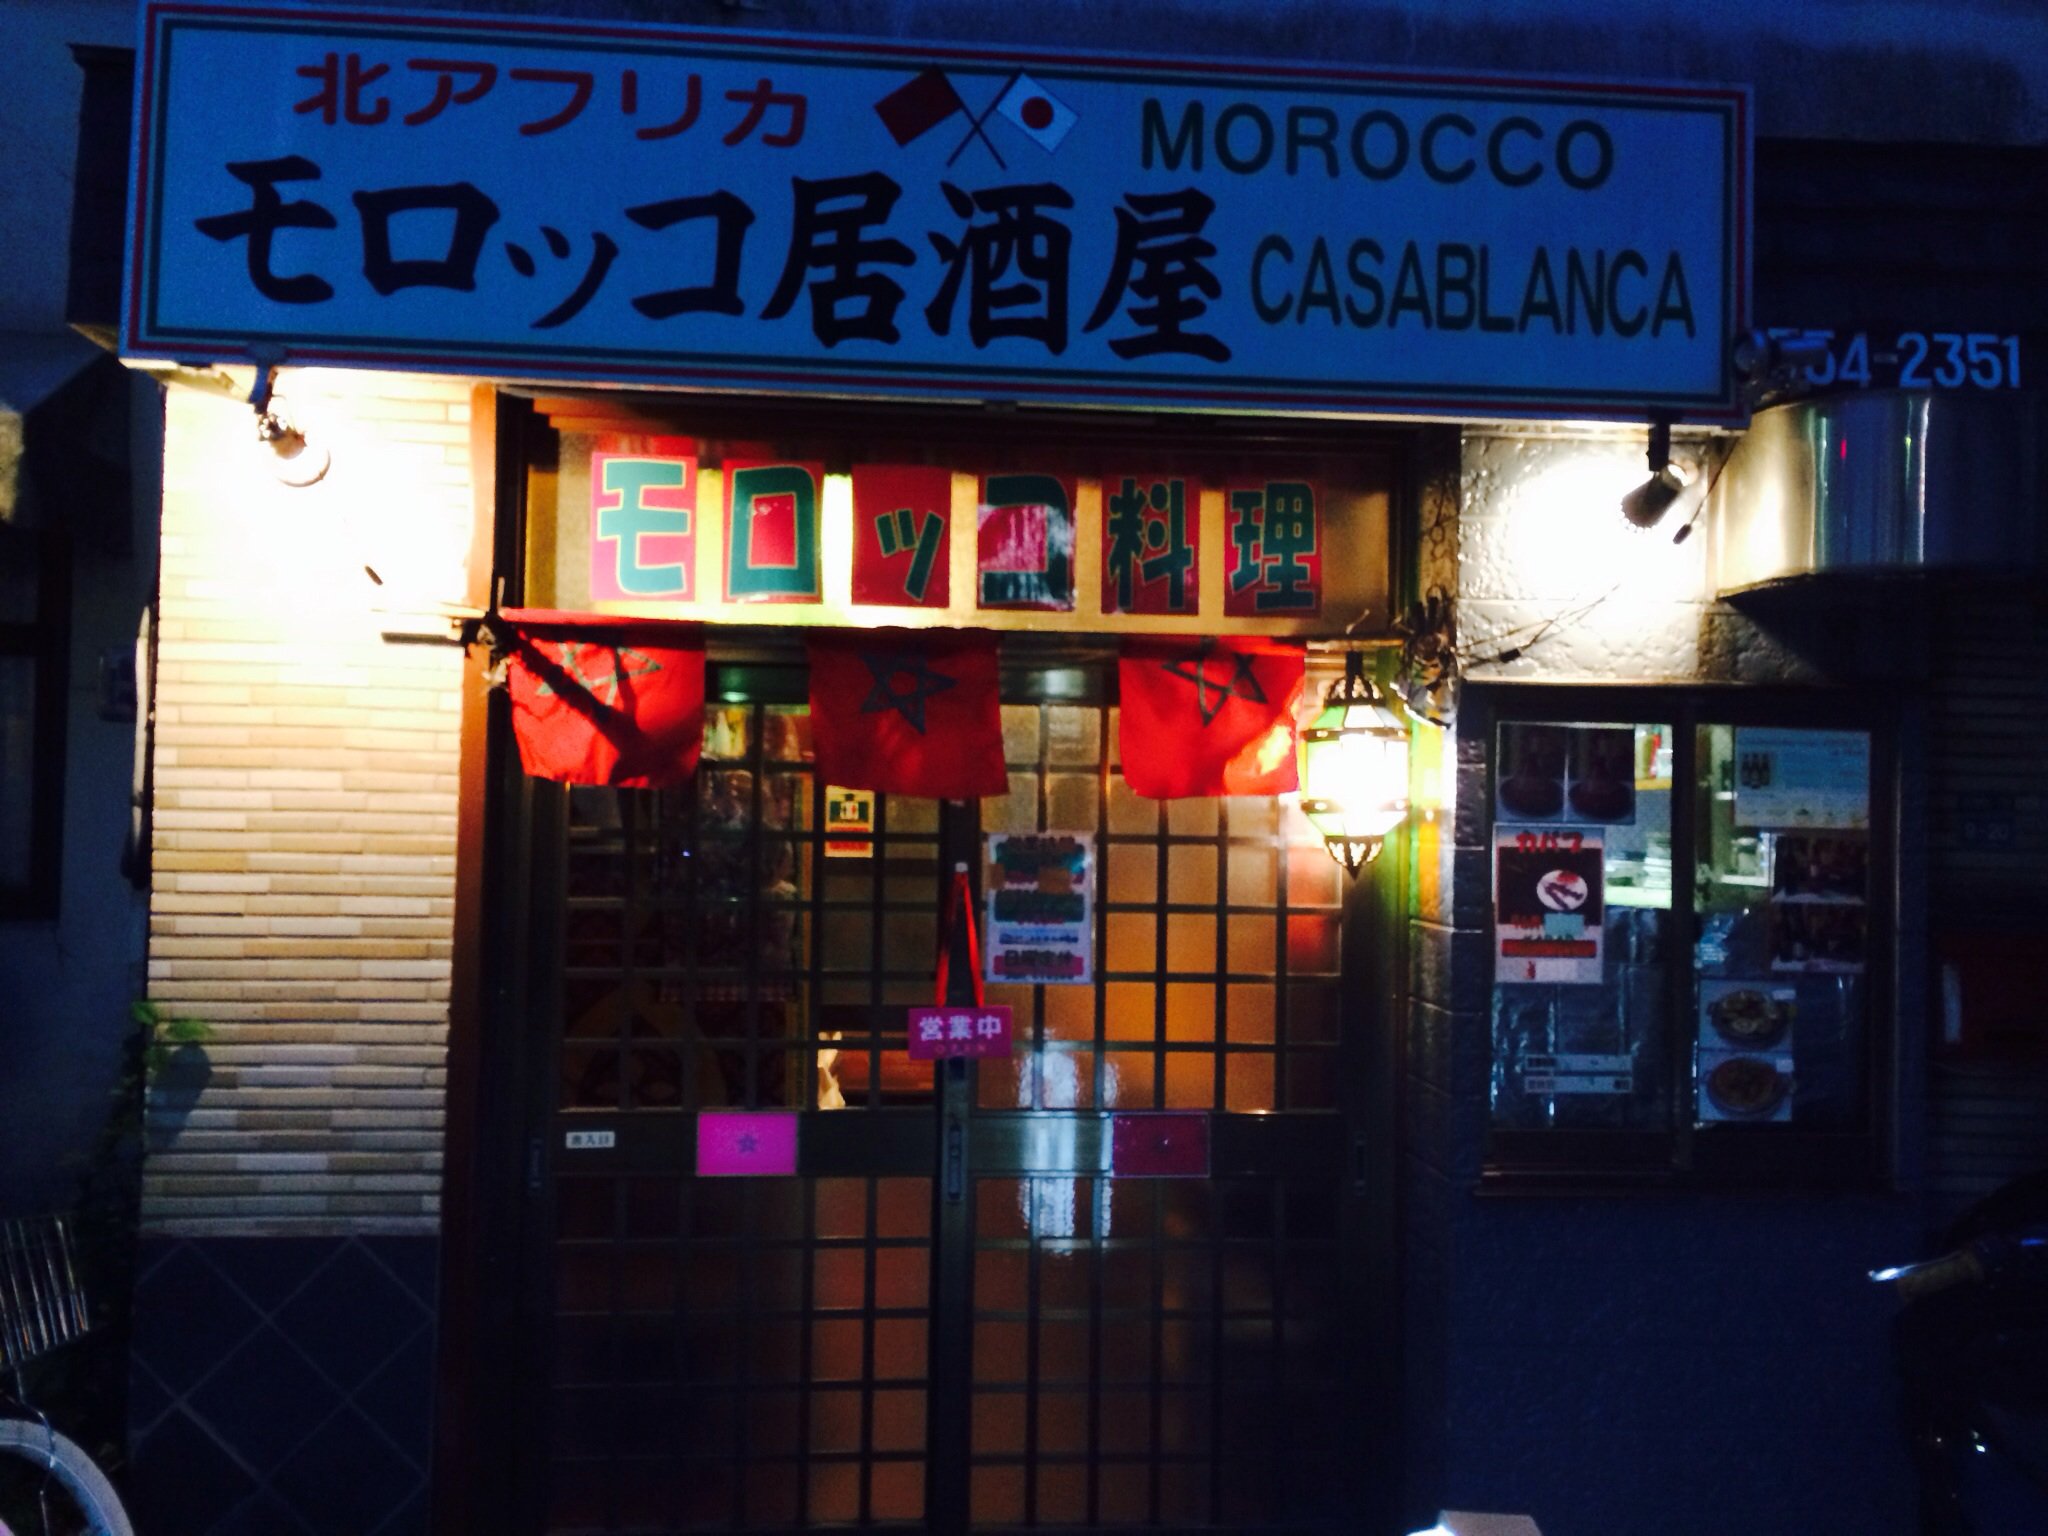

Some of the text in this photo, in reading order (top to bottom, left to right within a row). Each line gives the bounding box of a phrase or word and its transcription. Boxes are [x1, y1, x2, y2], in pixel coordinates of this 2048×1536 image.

[294, 52, 808, 148] 北アフリカ
[1142, 98, 1615, 190] MOROCCO
[195, 155, 1232, 363] モロッコ居酒屋
[1250, 234, 1695, 339] CASABLANCA
[597, 457, 1316, 611] モロッコ料理
[919, 1014, 1002, 1041] 営業中
